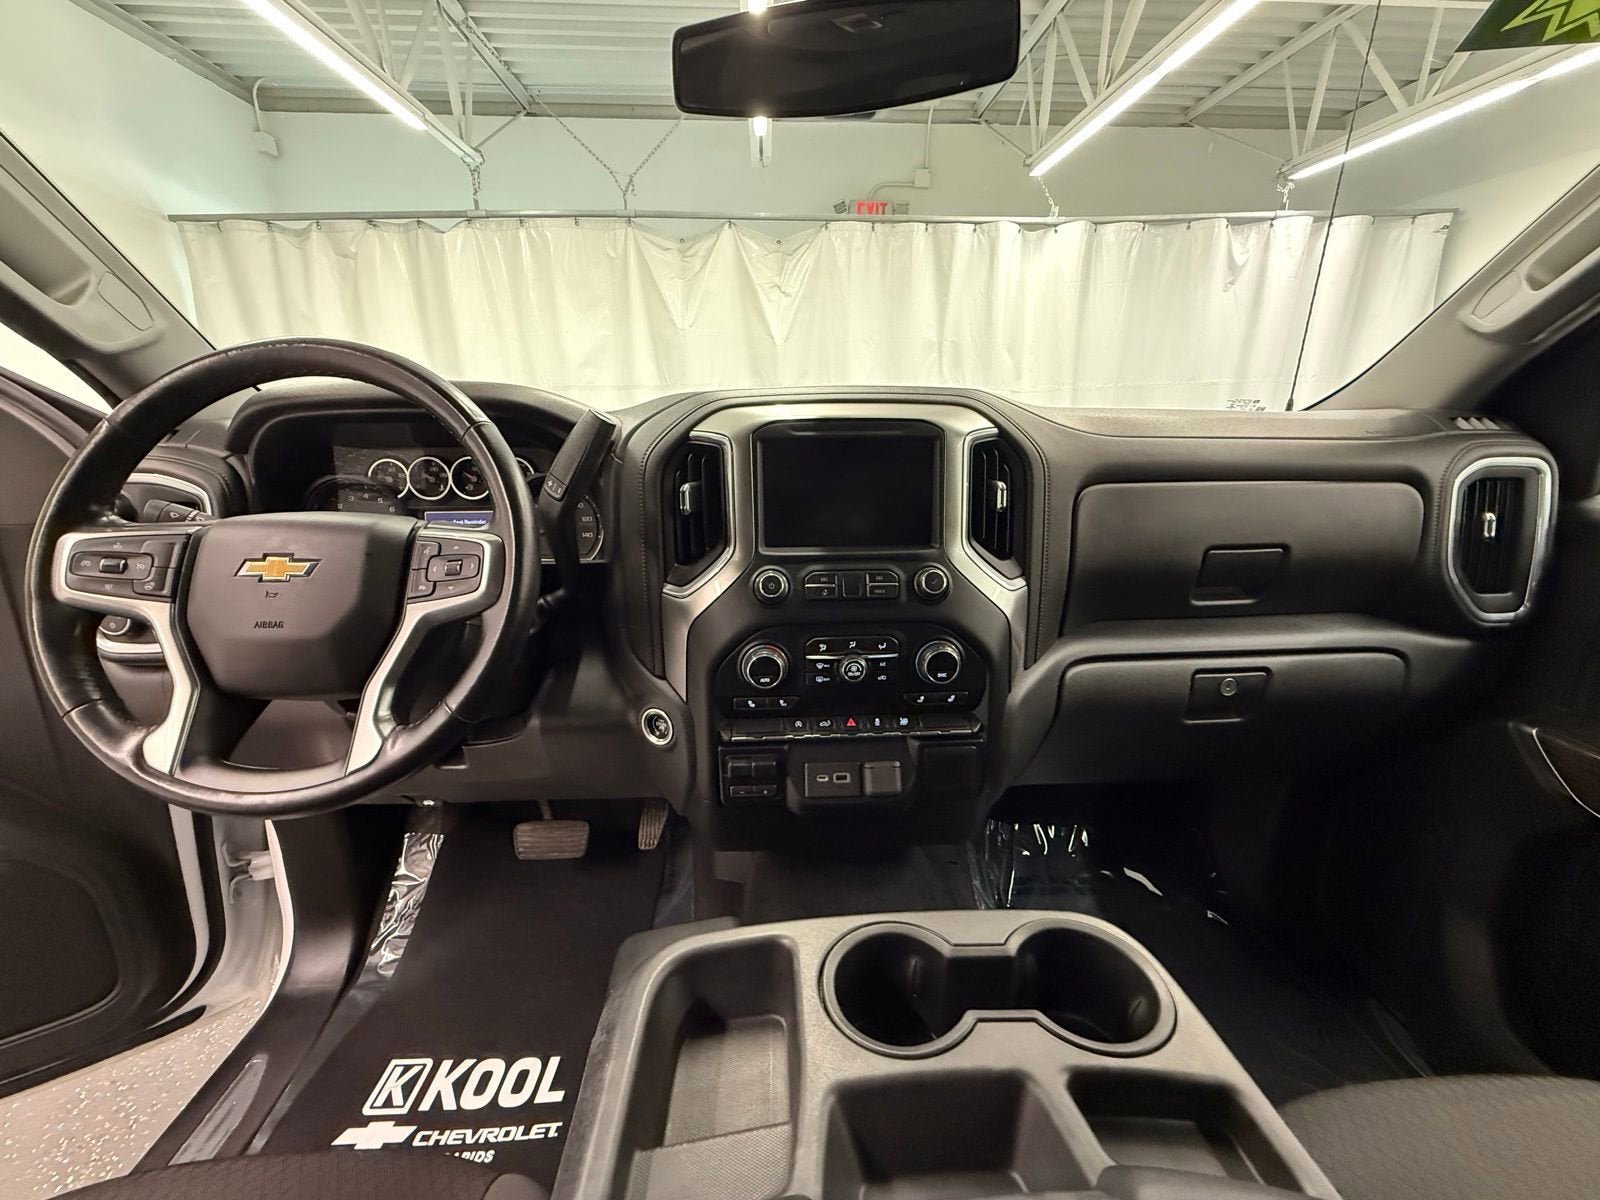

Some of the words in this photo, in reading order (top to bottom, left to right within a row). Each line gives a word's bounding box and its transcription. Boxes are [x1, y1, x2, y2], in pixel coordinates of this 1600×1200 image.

[253, 620, 285, 629] AIRBAG
[417, 1056, 566, 1112] KOOL
[412, 1122, 563, 1147] CHEVROLET
